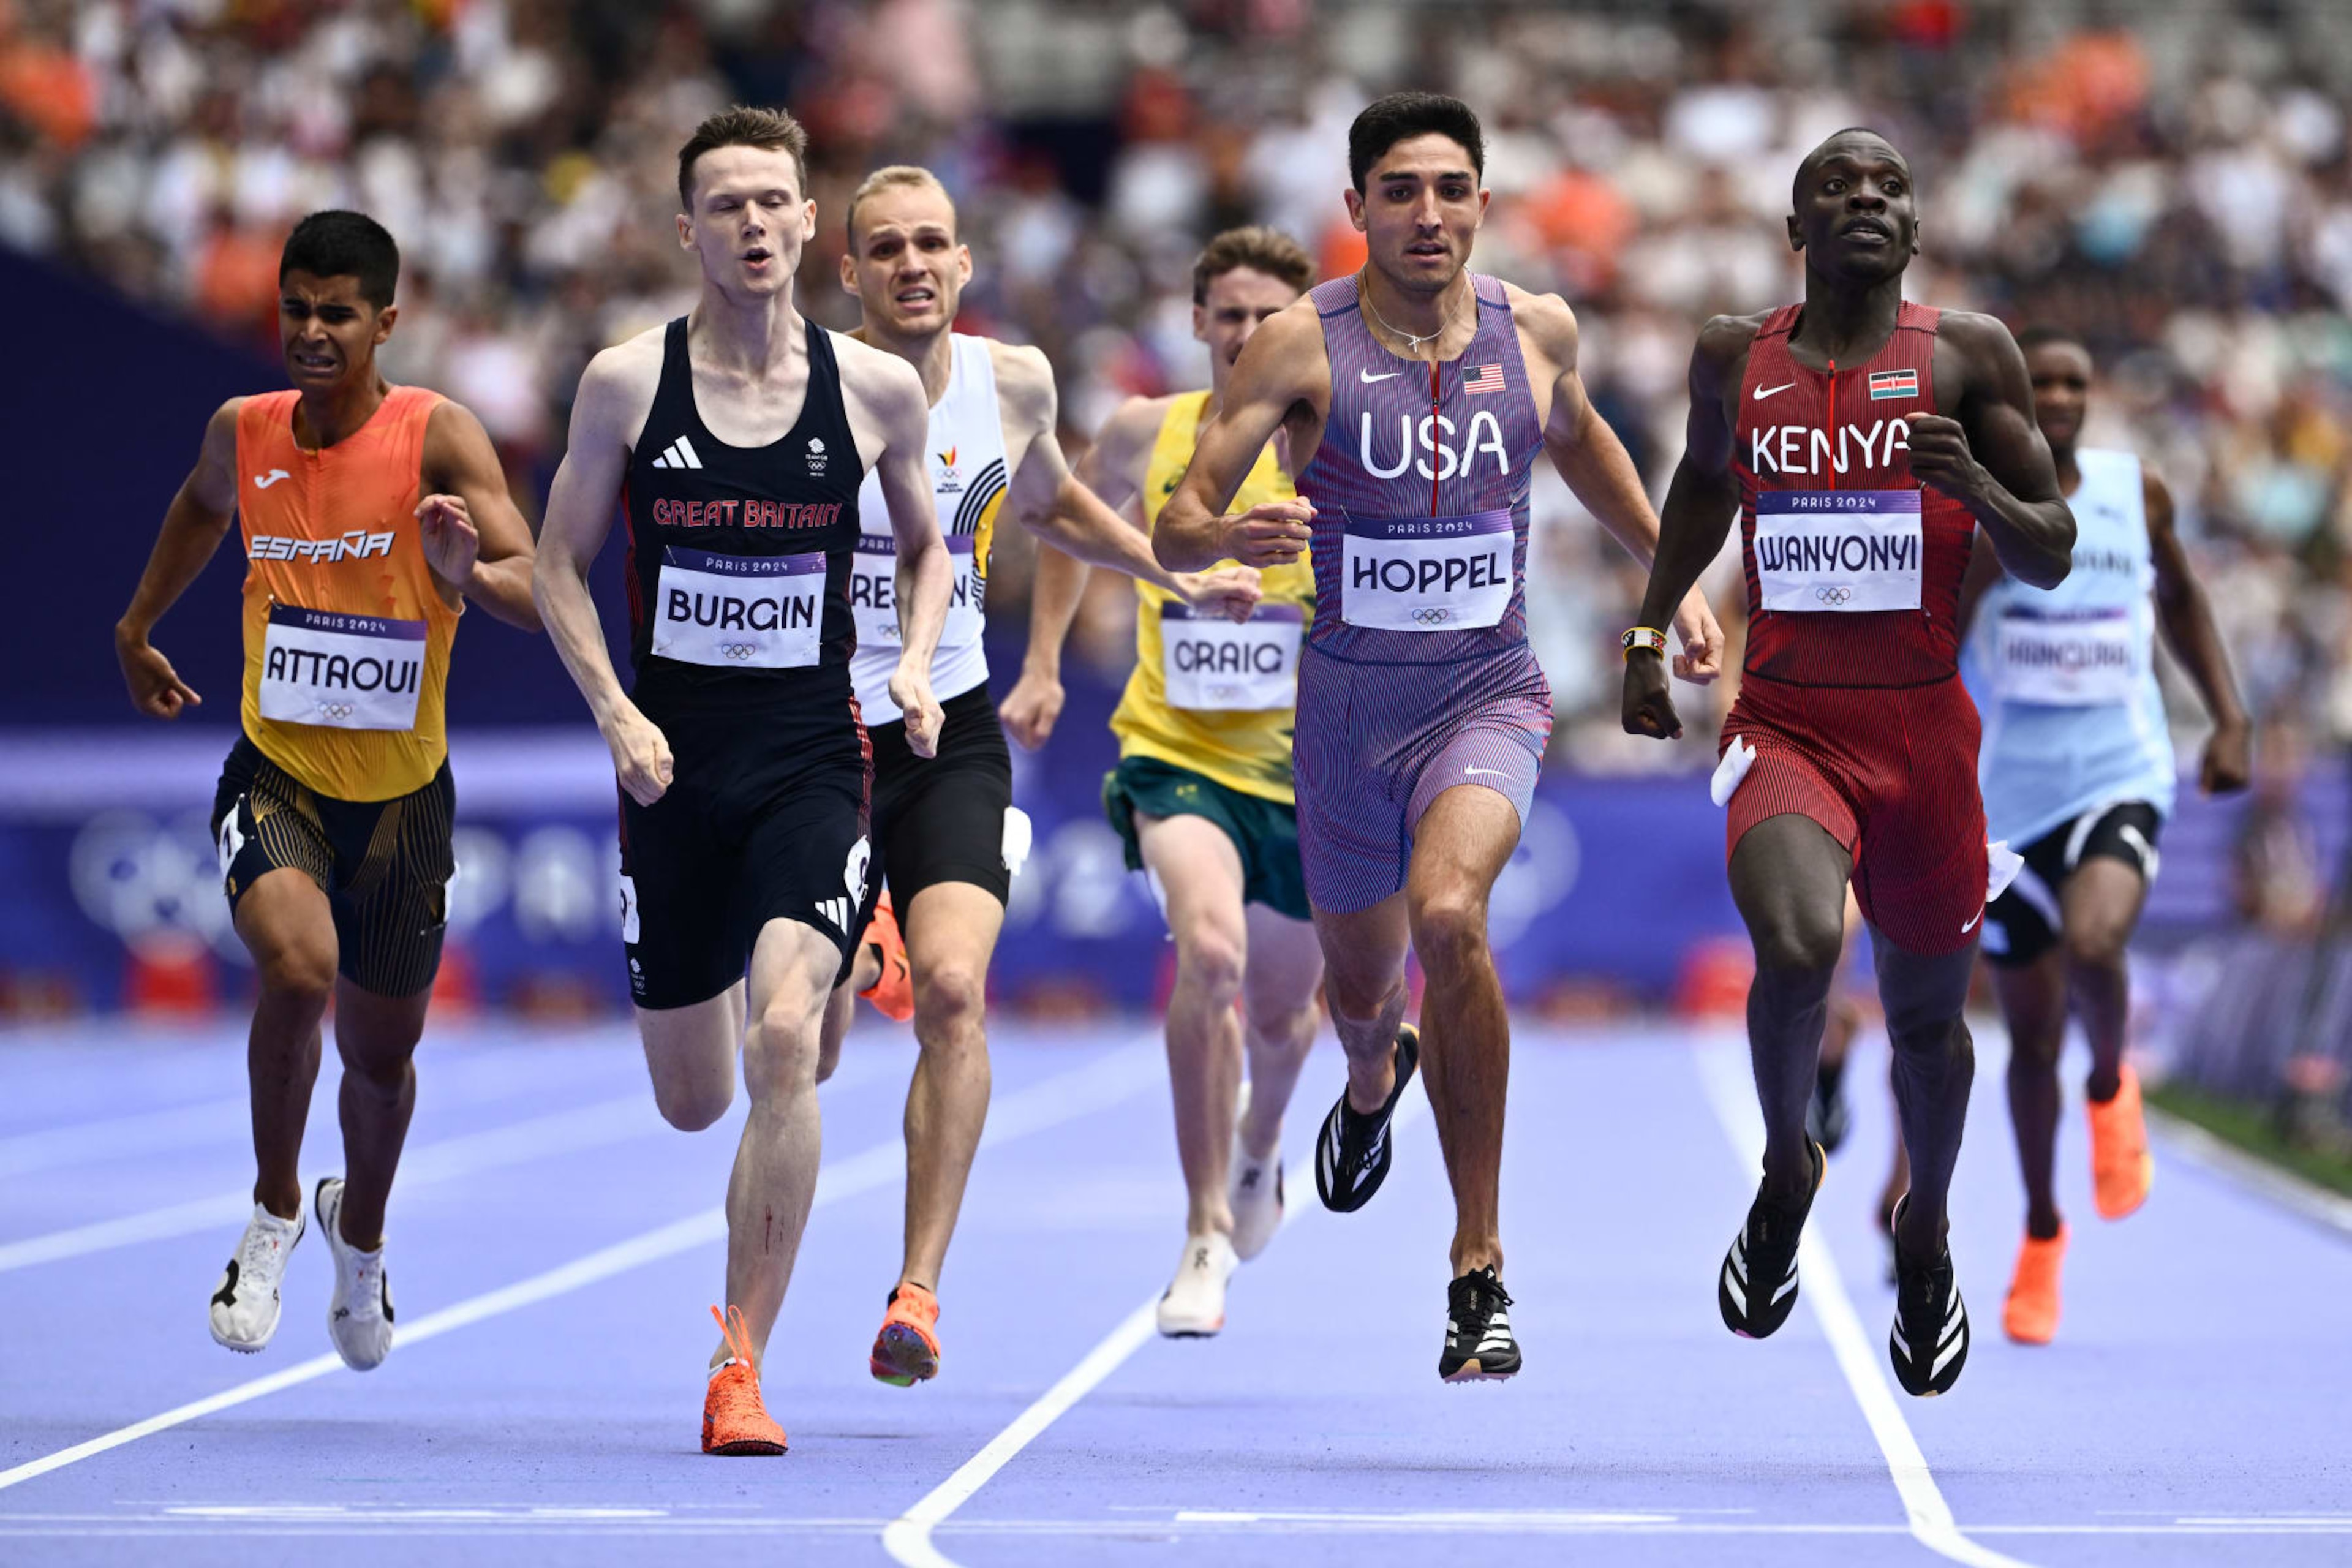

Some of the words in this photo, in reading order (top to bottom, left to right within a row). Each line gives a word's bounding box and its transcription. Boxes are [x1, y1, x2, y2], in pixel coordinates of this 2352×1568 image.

[1360, 410, 1509, 480] USA
[1752, 418, 1911, 475] KENYA
[653, 498, 739, 527] GREAT
[744, 500, 842, 529] BRITAIN
[1792, 497, 1831, 508] PARIS
[1837, 497, 1876, 508] 2024
[1388, 523, 1430, 534] PARIS
[1435, 521, 1473, 533] 2024
[247, 530, 396, 564] ESPAÑA
[1760, 534, 1917, 571] WANYONYI
[706, 557, 747, 571] PARIS
[753, 562, 788, 572] 2024
[1354, 552, 1506, 593] HOPPEL
[306, 614, 345, 628] PARIS
[349, 619, 386, 633] 2024
[668, 588, 815, 631] BURGIN
[267, 646, 418, 693] ATTAOUI
[1174, 640, 1283, 673] CRAIG
